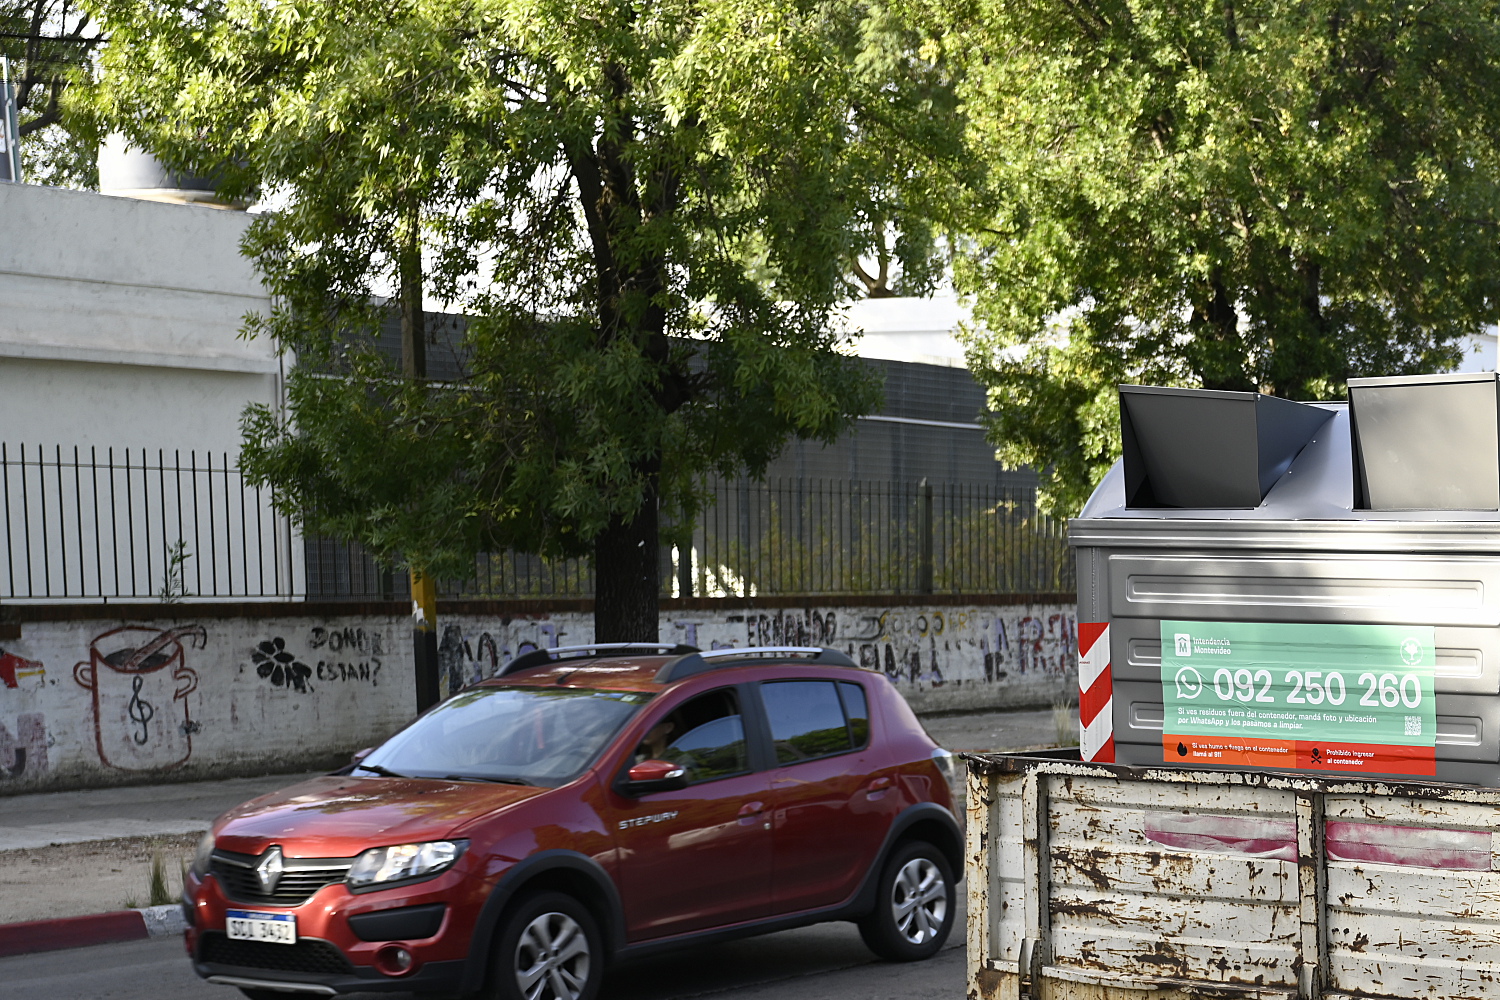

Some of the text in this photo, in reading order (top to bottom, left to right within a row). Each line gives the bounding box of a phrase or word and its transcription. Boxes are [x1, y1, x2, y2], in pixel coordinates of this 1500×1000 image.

[1193, 637, 1231, 646] Intendencia
[1194, 646, 1232, 655] Montevideo
[1213, 668, 1422, 709] 092 250 260
[1177, 707, 1185, 715] Si
[1200, 708, 1226, 716] residuos
[1228, 708, 1245, 717] fuera
[1247, 709, 1257, 718] del
[1258, 711, 1297, 720] contenedor,
[1298, 712, 1321, 721] mandá
[1323, 713, 1337, 722] foto
[1338, 715, 1343, 723] y
[1345, 714, 1377, 723] ubicación
[1190, 717, 1224, 726] WhatsApp
[1225, 719, 1230, 727] y
[1231, 718, 1241, 726] los
[1242, 719, 1272, 728] pasamos
[1279, 720, 1304, 730] limpiar.
[1258, 746, 1289, 754] contenedor
[1326, 749, 1375, 758] Prohibido ingresar
[1333, 758, 1364, 766] contenedor
[618, 811, 678, 830] STEPWAY
